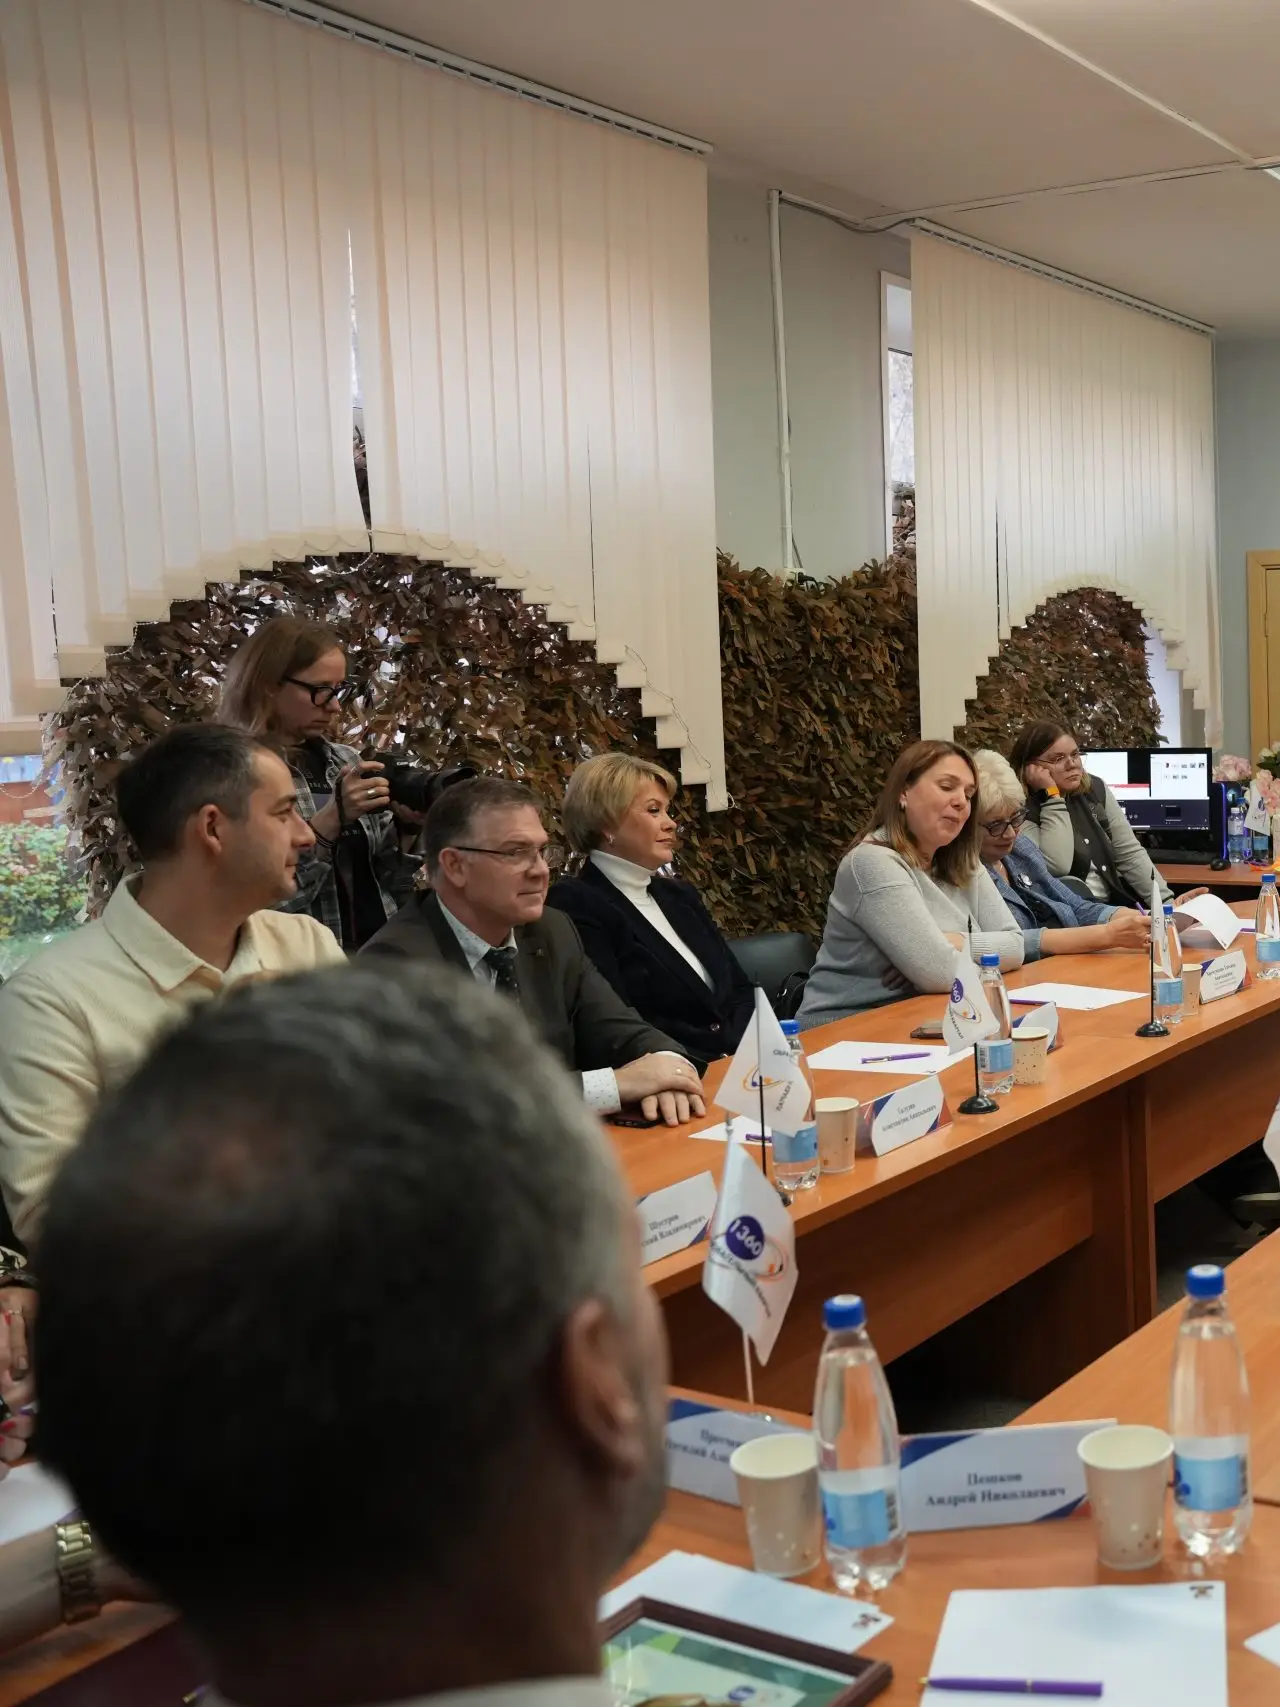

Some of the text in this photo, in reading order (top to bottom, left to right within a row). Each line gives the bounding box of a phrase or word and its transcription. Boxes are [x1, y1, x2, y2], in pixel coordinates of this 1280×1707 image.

[730, 1219, 763, 1256] 1360
[926, 1486, 1066, 1507] Андрей Николаевич
